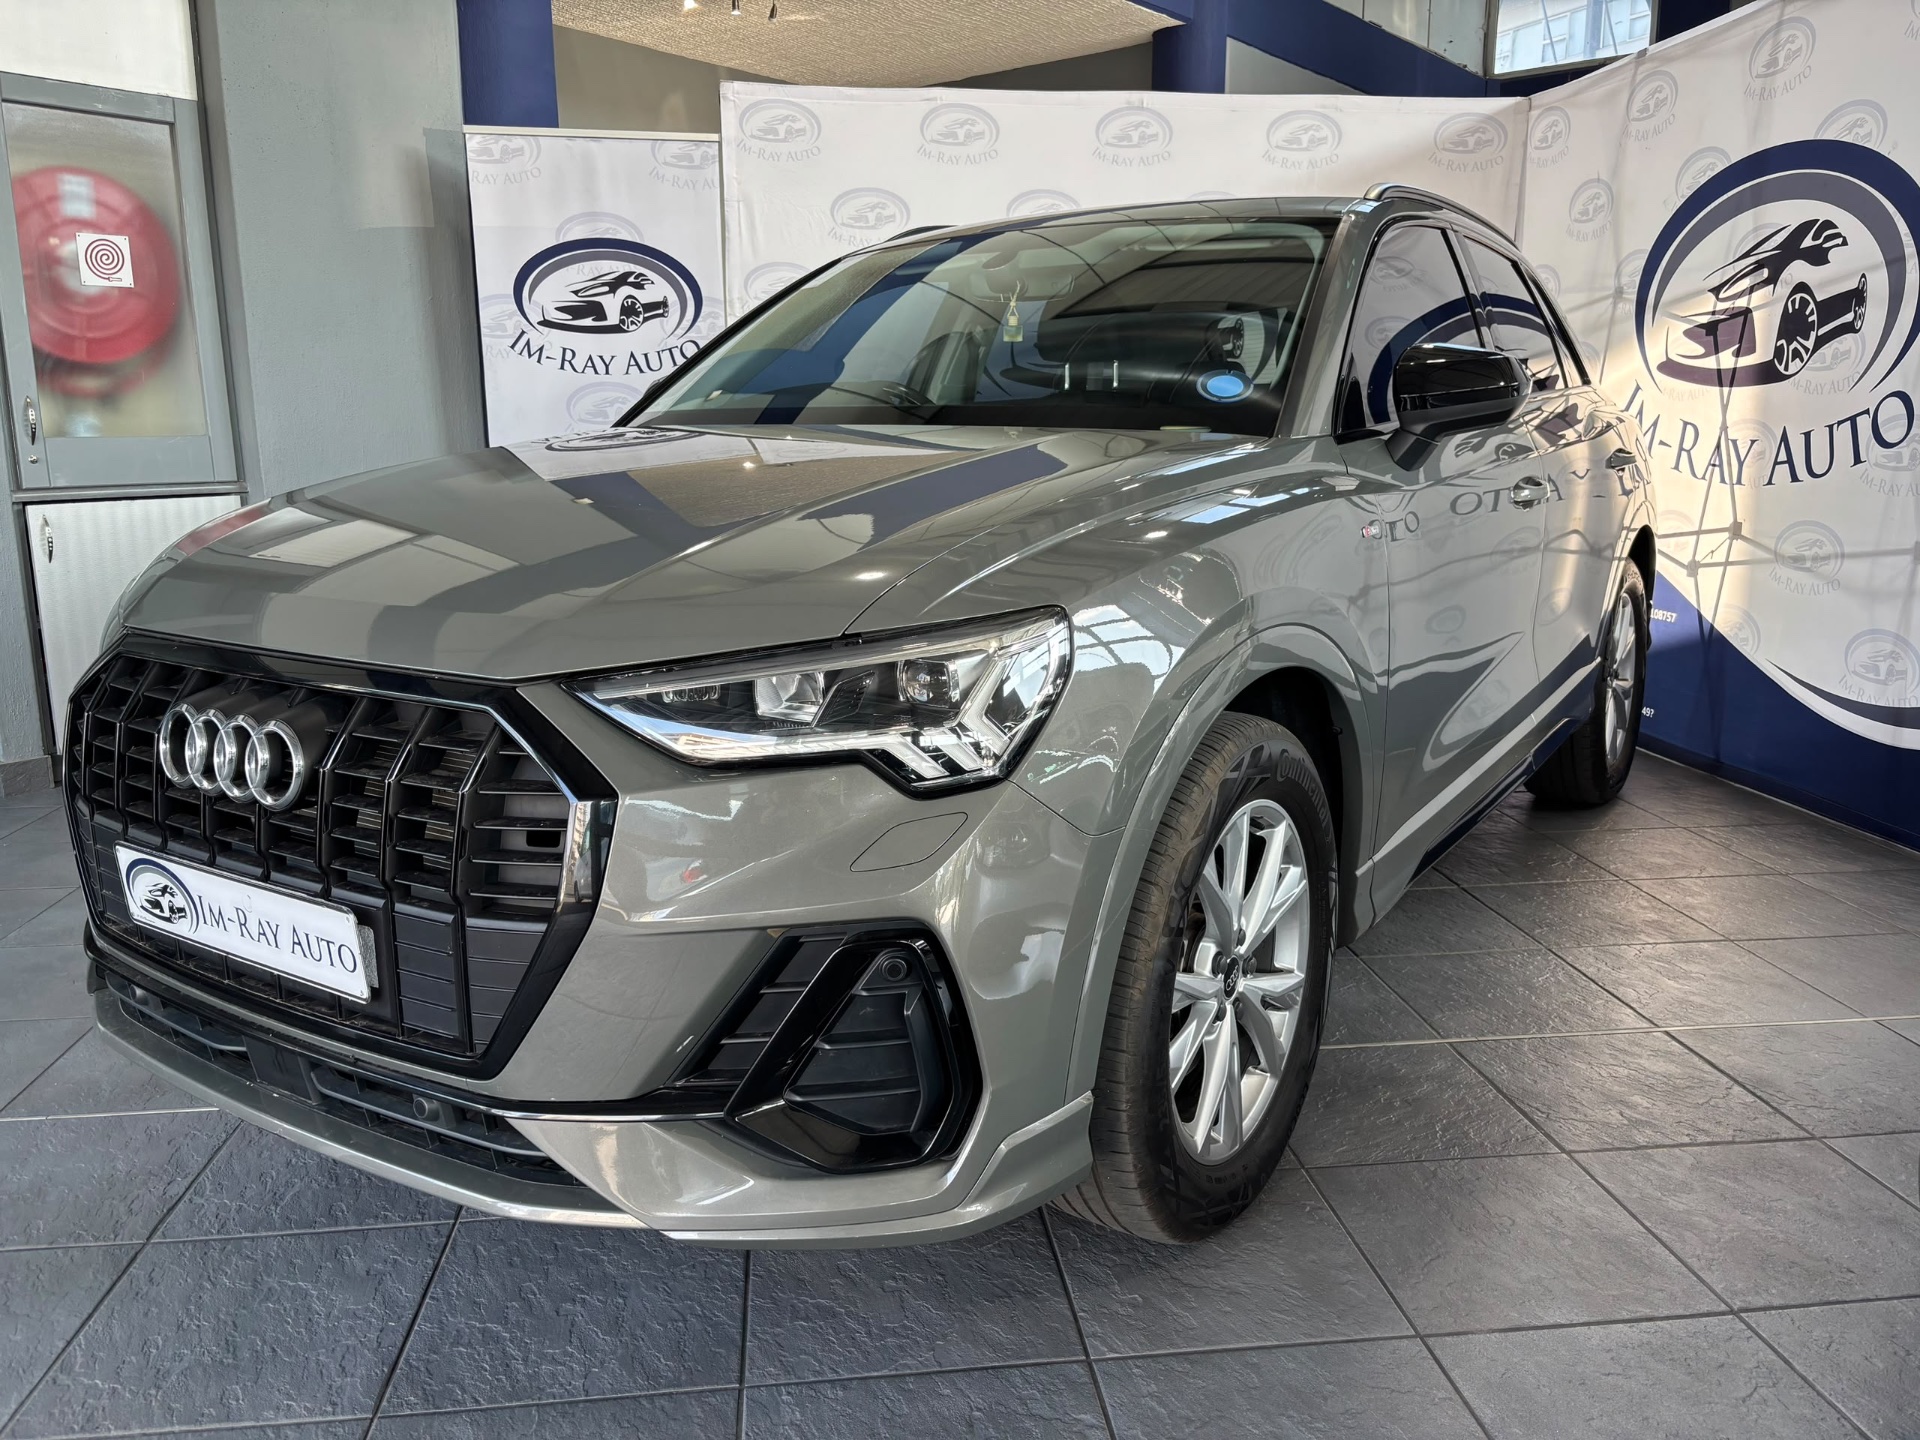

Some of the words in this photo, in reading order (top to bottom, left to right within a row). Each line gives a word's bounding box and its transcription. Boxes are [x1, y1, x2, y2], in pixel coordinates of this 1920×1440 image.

[1781, 64, 1813, 97] AUTO
[1651, 113, 1676, 139] AUTO
[736, 138, 783, 163] IM-RAY
[785, 145, 822, 163] AUTO
[916, 143, 961, 166] IM-RAY
[963, 148, 999, 166] AUTO
[1137, 149, 1172, 168] AUTO
[1306, 151, 1339, 171] AUTO
[1427, 151, 1469, 173] IM-RAY
[1470, 154, 1504, 173] AUTO
[503, 166, 542, 185] AUTO
[649, 166, 699, 191] IM-RAY
[508, 328, 617, 376] IM-RAY
[622, 339, 702, 376] AUTO
[1787, 376, 1827, 396] M-RAY
[1617, 378, 1759, 487] IM-RAY
[1762, 389, 1916, 487] AUTO
[1859, 468, 1904, 497] IM-RAY
[1768, 566, 1807, 595] IM-RAY
[1808, 578, 1841, 597] AUTO
[197, 895, 281, 950] IM-RAY
[291, 924, 358, 974] AUTO
